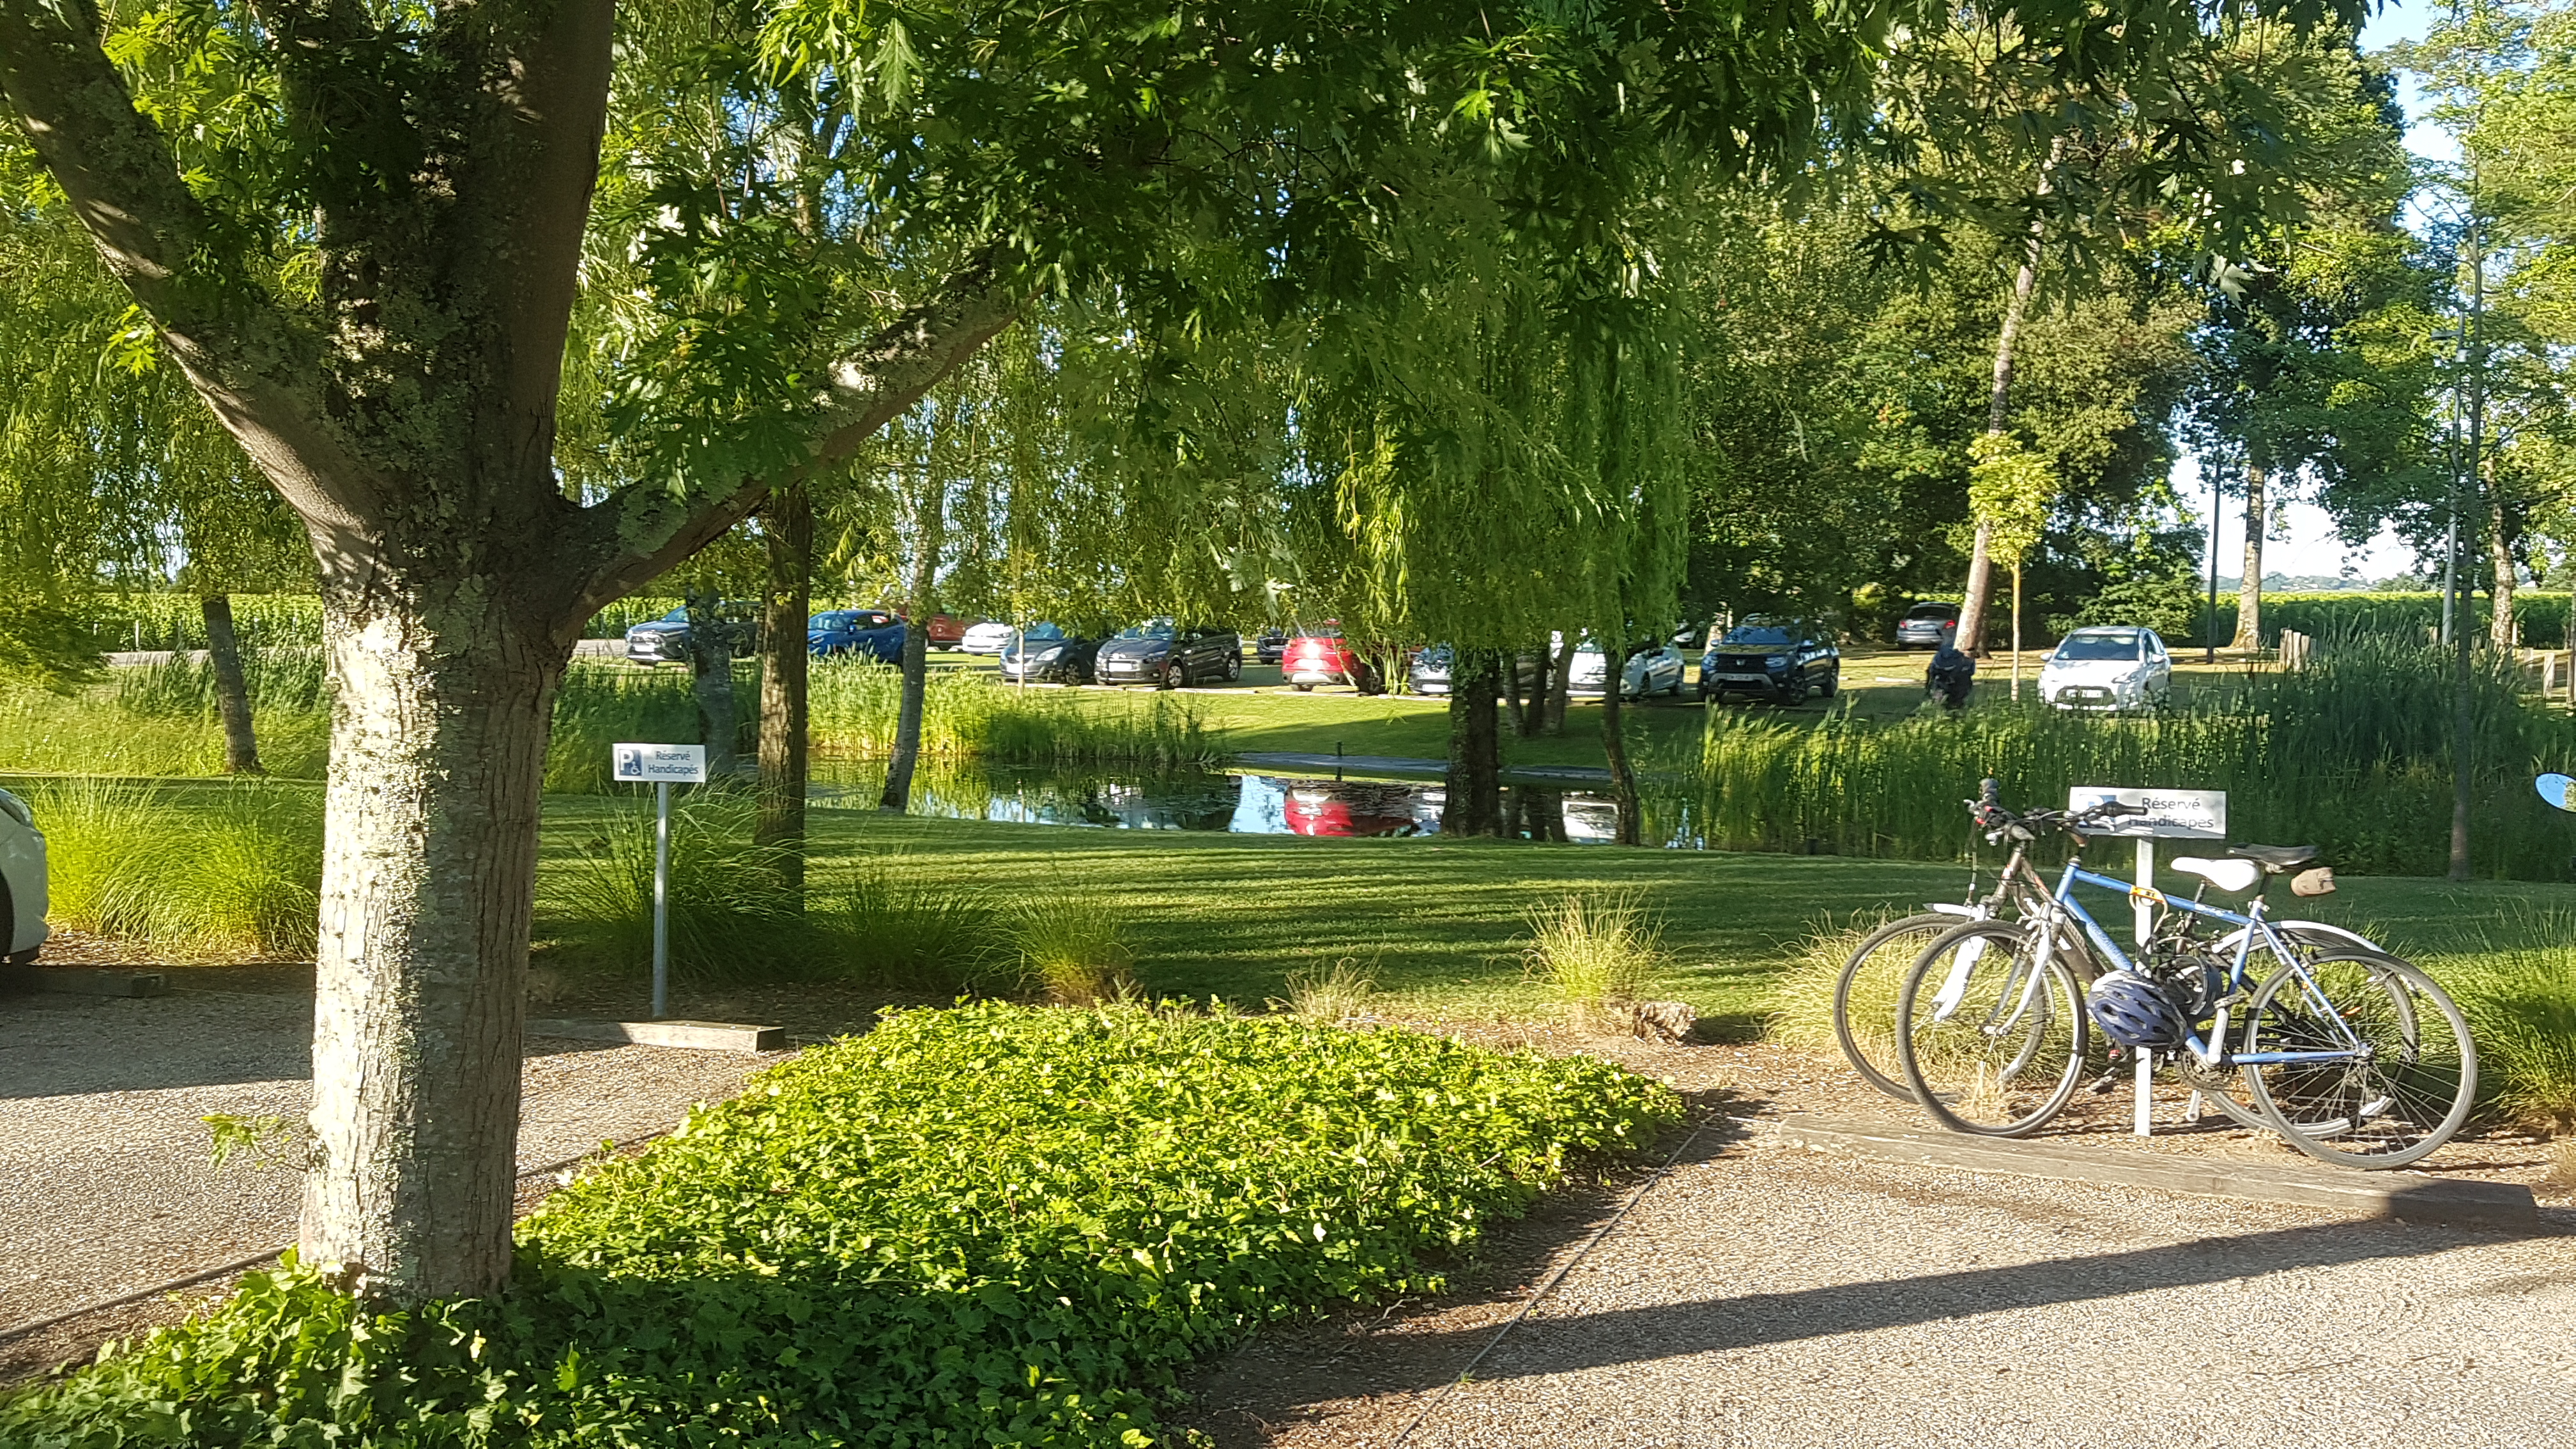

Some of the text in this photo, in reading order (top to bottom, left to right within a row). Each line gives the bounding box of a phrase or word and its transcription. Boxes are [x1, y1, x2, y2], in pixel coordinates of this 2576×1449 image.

[620, 749, 634, 770] P
[656, 750, 691, 760] Réservé
[648, 763, 698, 776] Handicapés
[2142, 797, 2201, 809] Réservé
